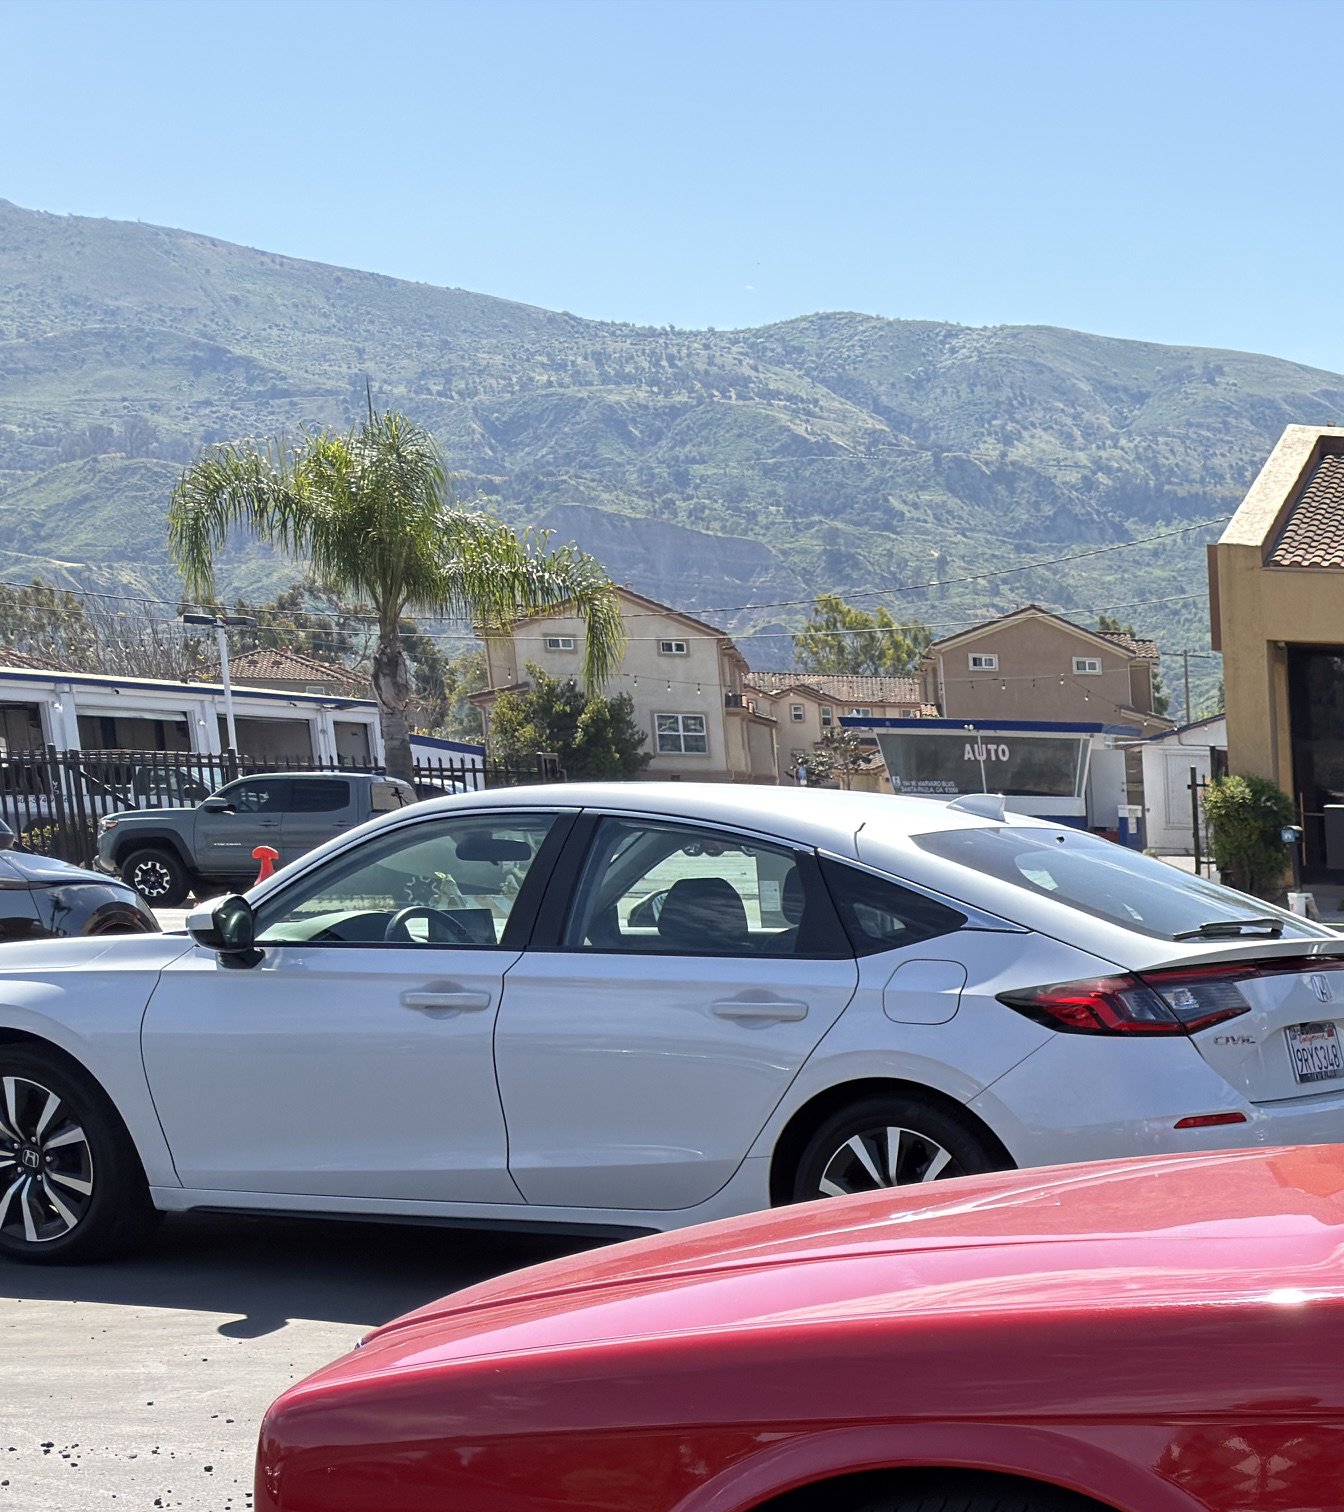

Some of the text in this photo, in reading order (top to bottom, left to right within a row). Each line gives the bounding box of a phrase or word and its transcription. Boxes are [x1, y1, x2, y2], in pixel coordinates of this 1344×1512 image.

[963, 743, 1010, 761] AUTO
[1213, 1036, 1256, 1046] CIVIC
[1295, 1045, 1341, 1074] 9RYS348
